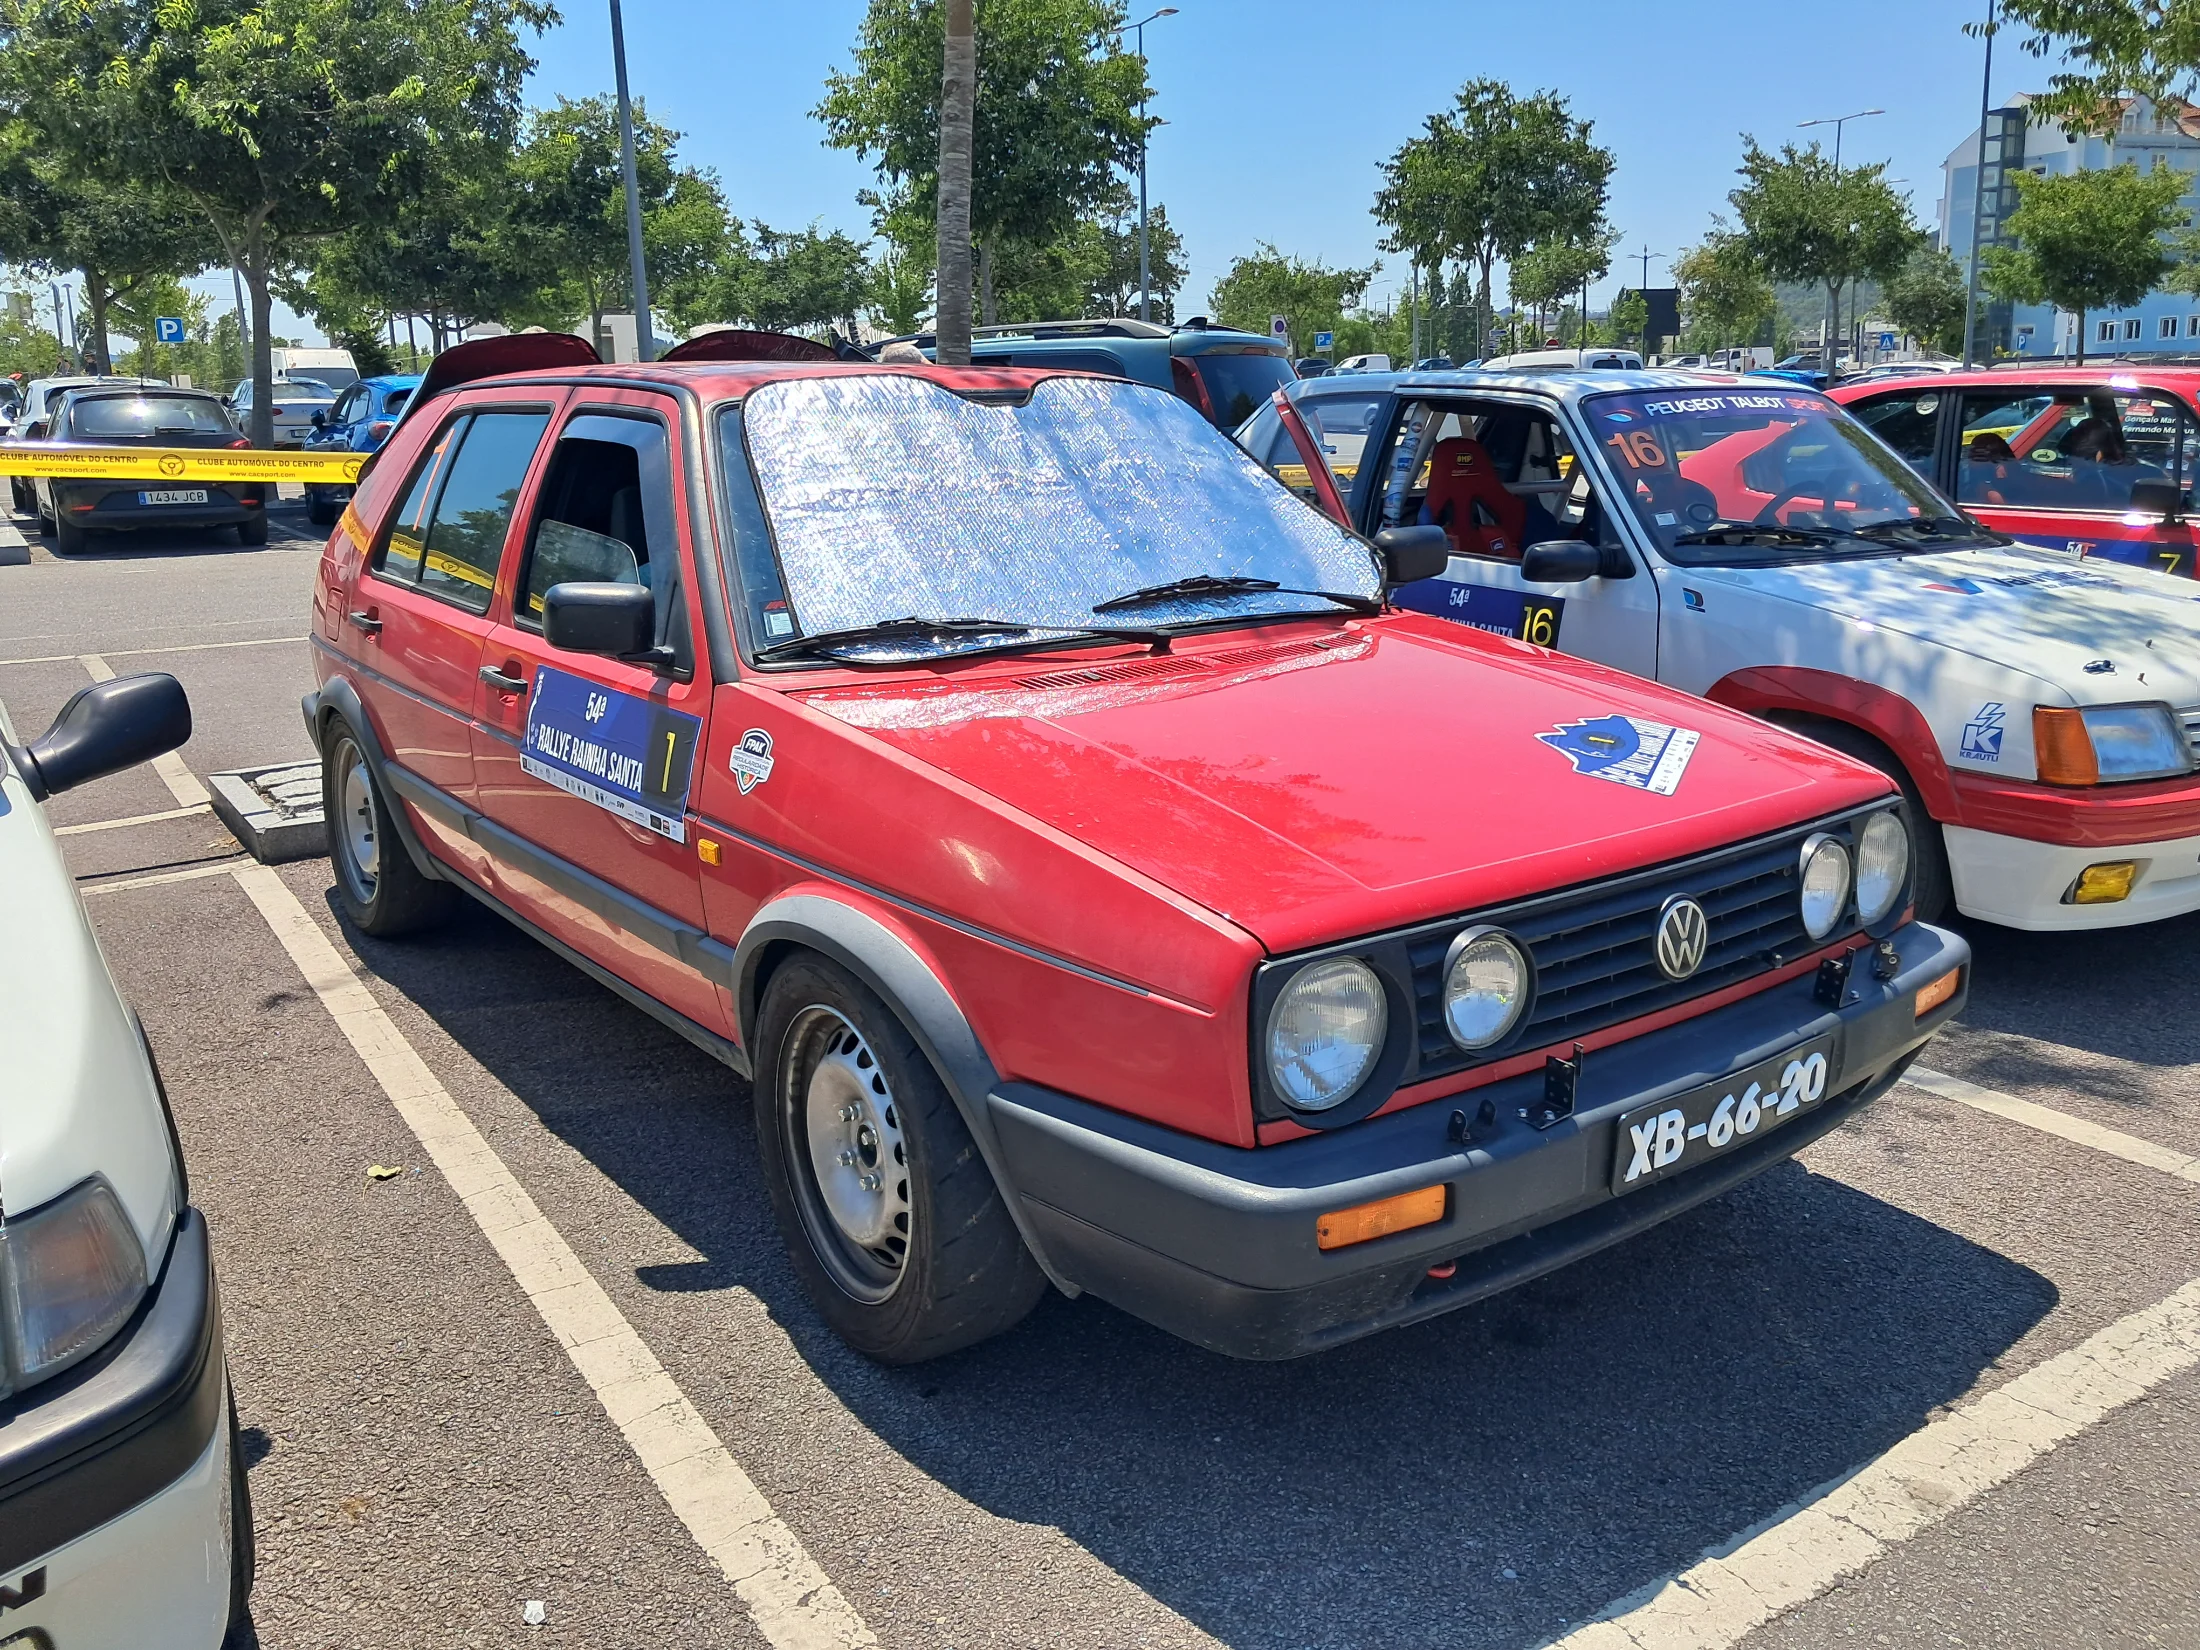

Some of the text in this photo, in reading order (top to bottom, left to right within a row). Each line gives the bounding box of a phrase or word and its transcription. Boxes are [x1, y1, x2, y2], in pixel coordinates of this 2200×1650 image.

[161, 320, 178, 340] P
[2018, 335, 2026, 349] P
[1644, 396, 1830, 417] PEUGEOT TALBOT SPORT
[2124, 415, 2159, 424] Gonçalo
[2121, 425, 2195, 435] Fernando Maus
[1607, 431, 1666, 469] 16
[0, 452, 138, 464] CLUBE AUTOMÓVEL DO CENTRO
[197, 457, 325, 468] CLUBE AUTOMÓVEL DO CENTRO
[34, 466, 107, 475] www.cacsport.com
[229, 470, 296, 479] www.cacsport.com
[150, 490, 205, 503] 1434 JCB
[2159, 553, 2181, 574] 7
[1523, 606, 1554, 646] 16
[745, 738, 767, 754] FPAK
[537, 723, 572, 763] RALLYE
[569, 736, 608, 778] RAINHA
[607, 751, 644, 793] SANTA
[661, 731, 676, 793] 1
[1959, 750, 1999, 762] KRAUTLI
[1624, 1052, 1827, 1183] XB-66-20
